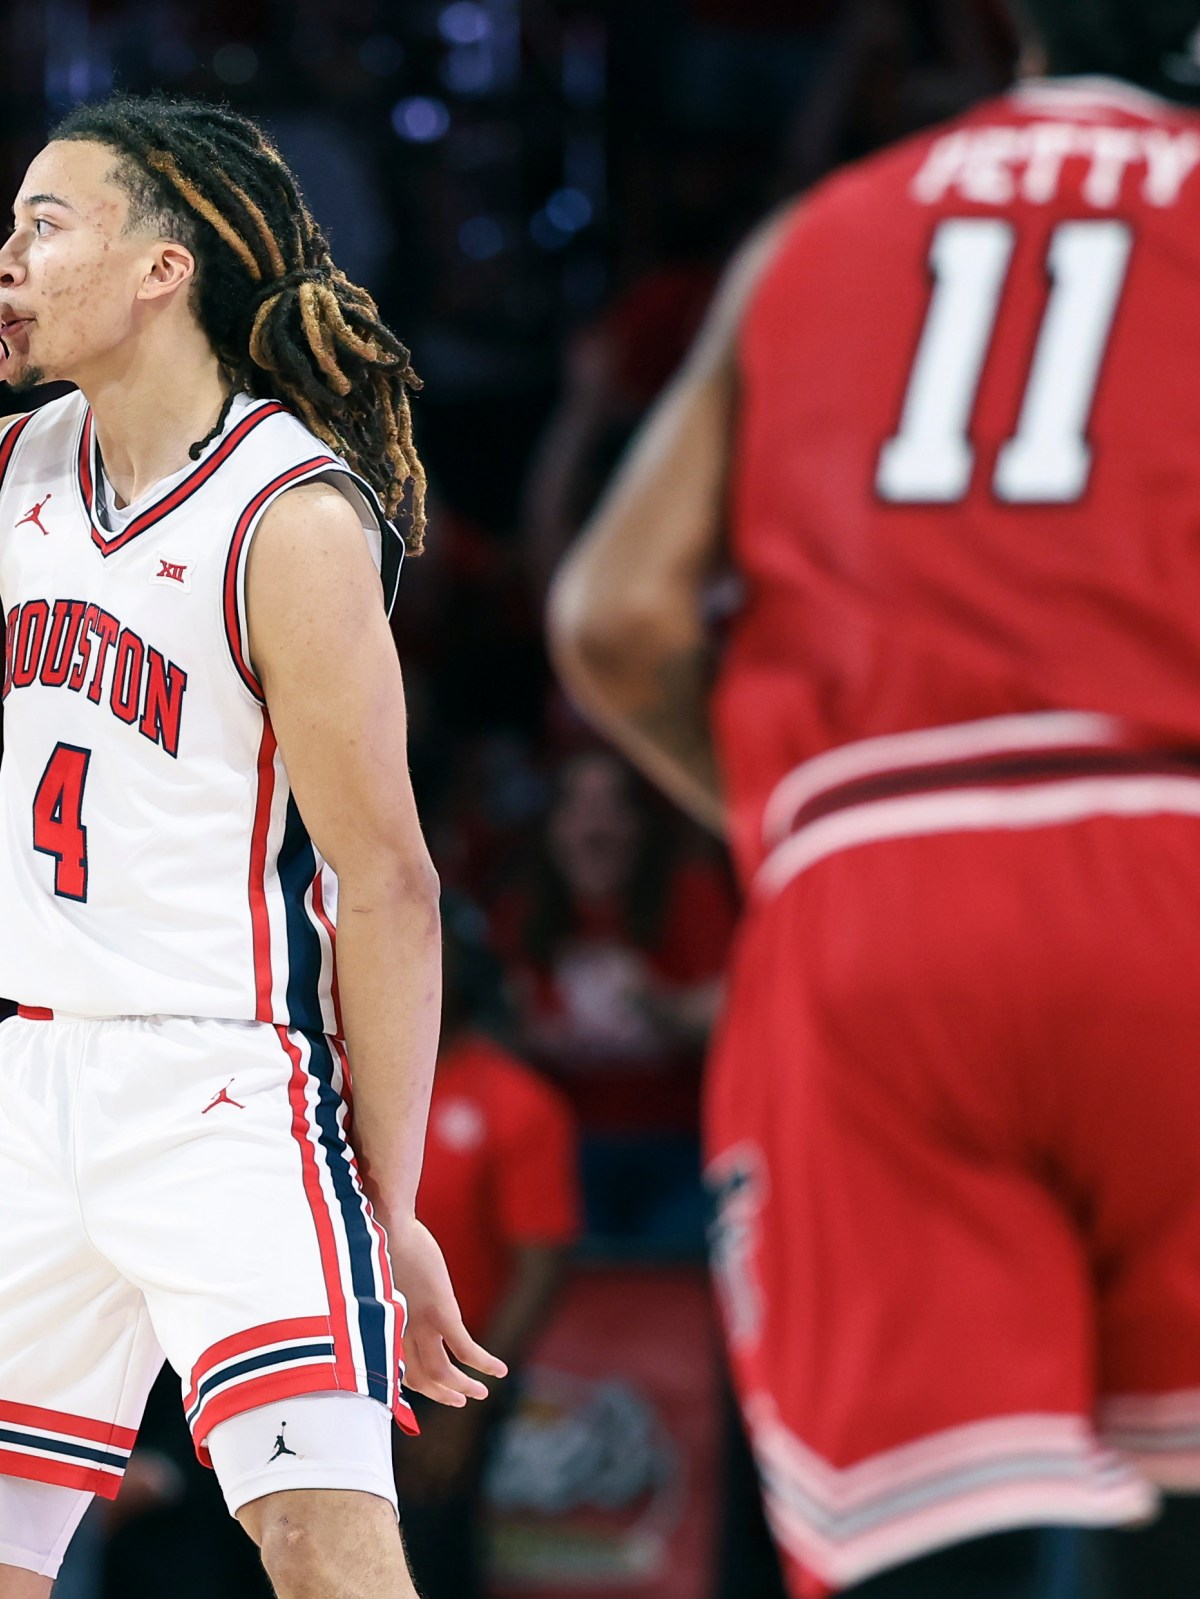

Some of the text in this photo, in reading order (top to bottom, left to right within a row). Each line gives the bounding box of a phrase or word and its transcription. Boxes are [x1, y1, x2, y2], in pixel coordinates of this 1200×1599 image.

[874, 215, 1134, 505] 11
[156, 559, 187, 583] XII
[32, 741, 91, 903] 4
